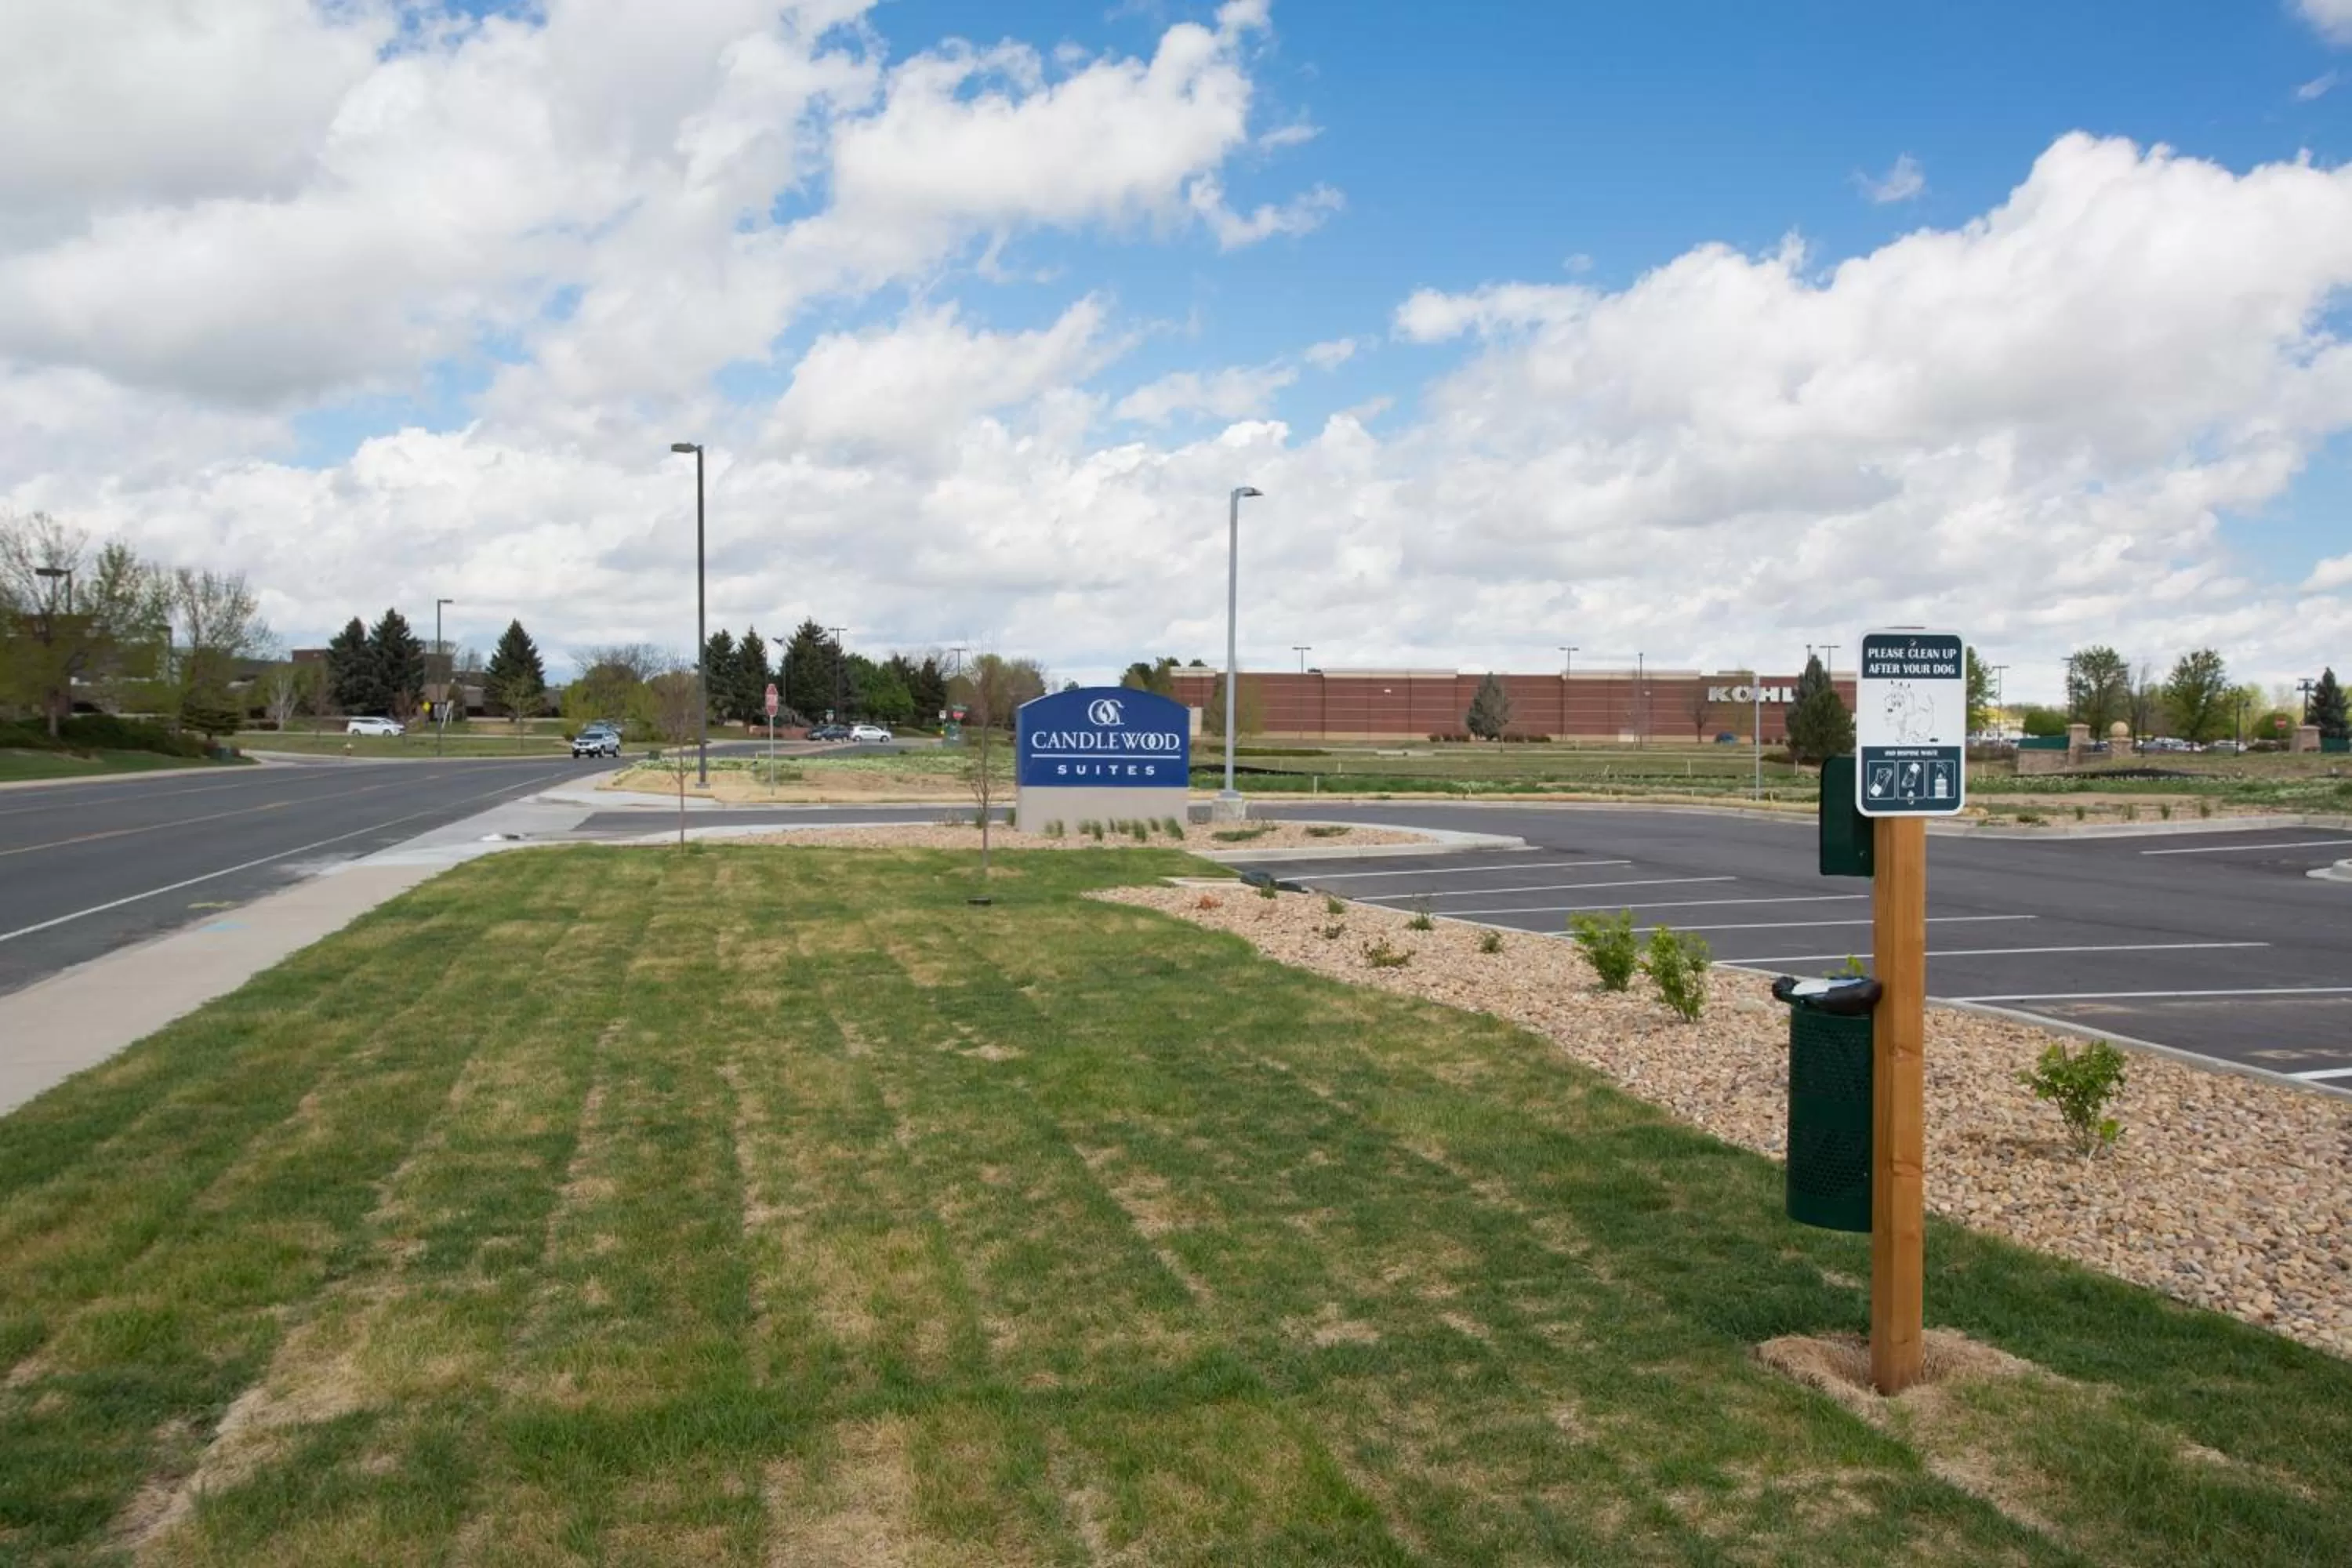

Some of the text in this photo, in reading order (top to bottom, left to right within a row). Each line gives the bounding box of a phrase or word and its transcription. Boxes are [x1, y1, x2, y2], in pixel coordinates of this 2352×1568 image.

[1868, 648, 1957, 659] PLEASE CLEAN UP
[1868, 663, 1955, 674] AFTER YOUR DOG
[1708, 685, 1798, 702] KOHL
[1031, 731, 1181, 750] CANDLEWOOD
[1058, 765, 1155, 775] SUITES
